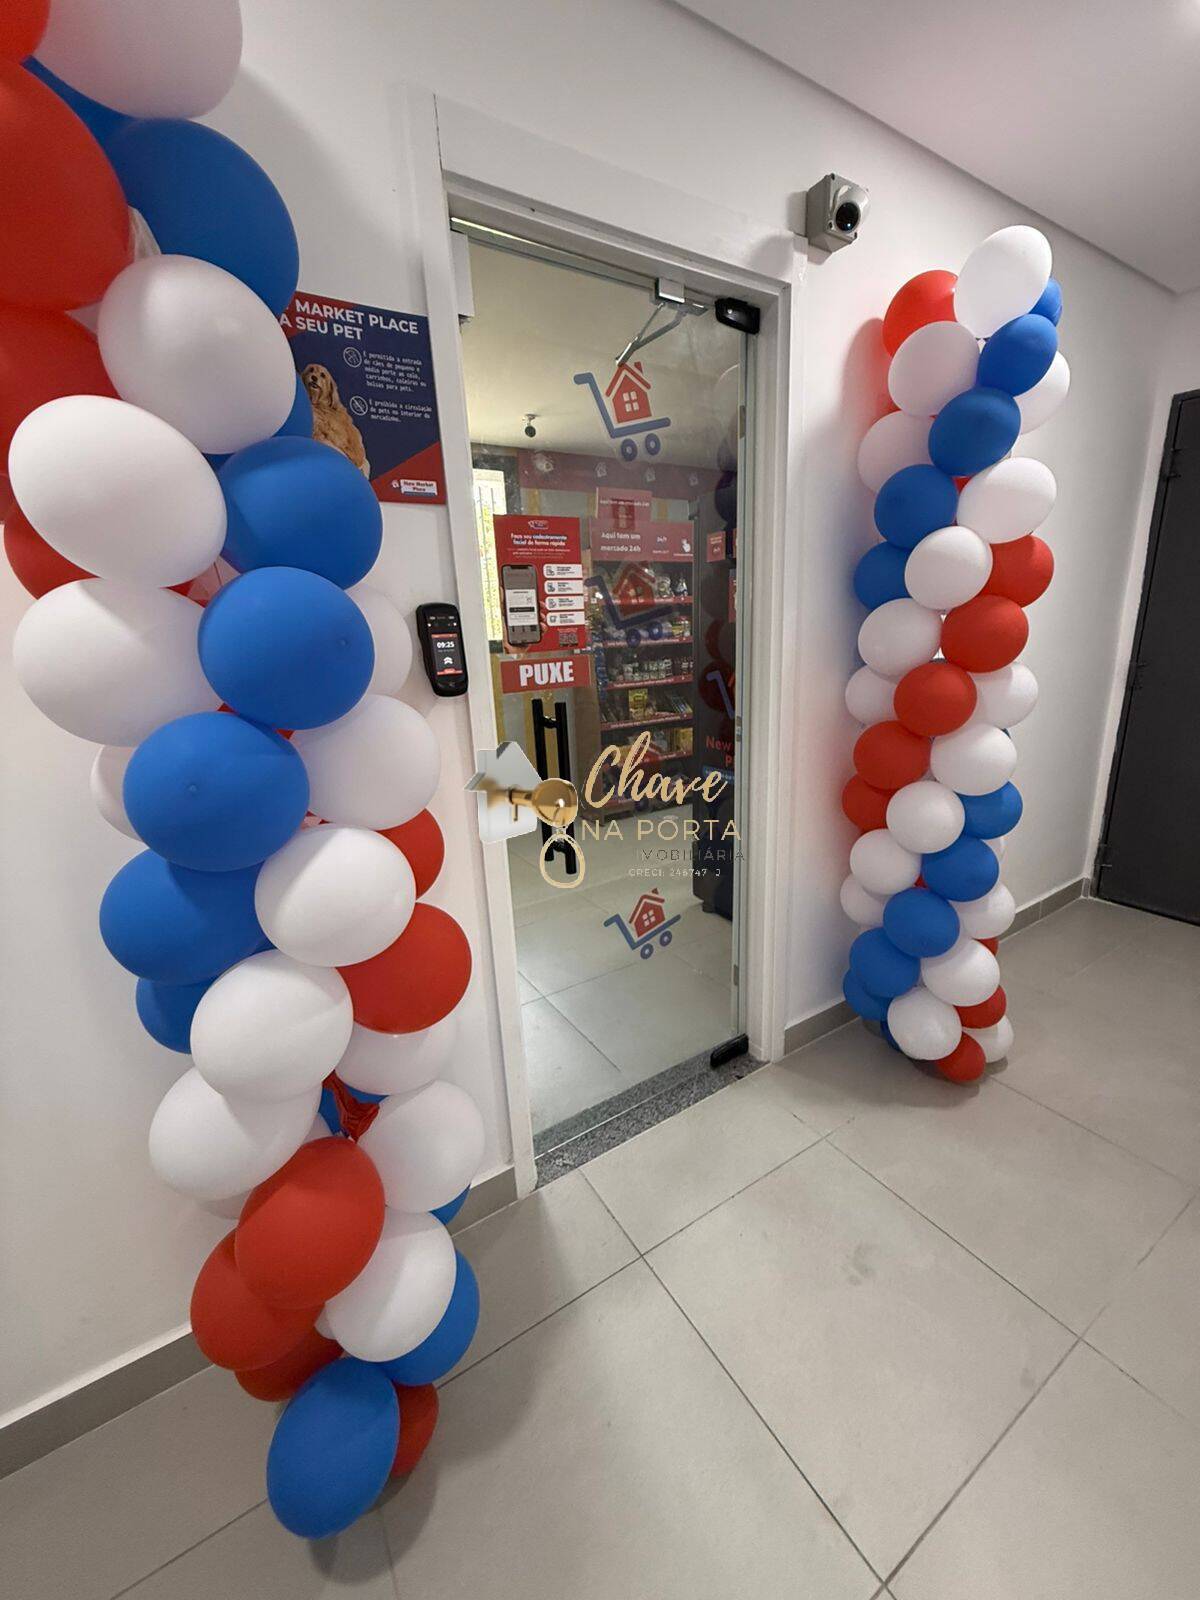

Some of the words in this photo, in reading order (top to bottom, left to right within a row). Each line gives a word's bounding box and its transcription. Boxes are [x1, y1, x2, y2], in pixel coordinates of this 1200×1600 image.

[295, 299, 364, 324] MARKET
[368, 314, 419, 335] PLACE
[296, 316, 328, 334] SEU
[333, 323, 363, 340] PET
[601, 531, 616, 541] Aqui
[616, 531, 630, 540] tem
[600, 544, 629, 553] mercado
[629, 545, 642, 553] 24h
[436, 641, 455, 649] 09:25
[518, 660, 575, 688] PUXE
[706, 735, 732, 751] New
